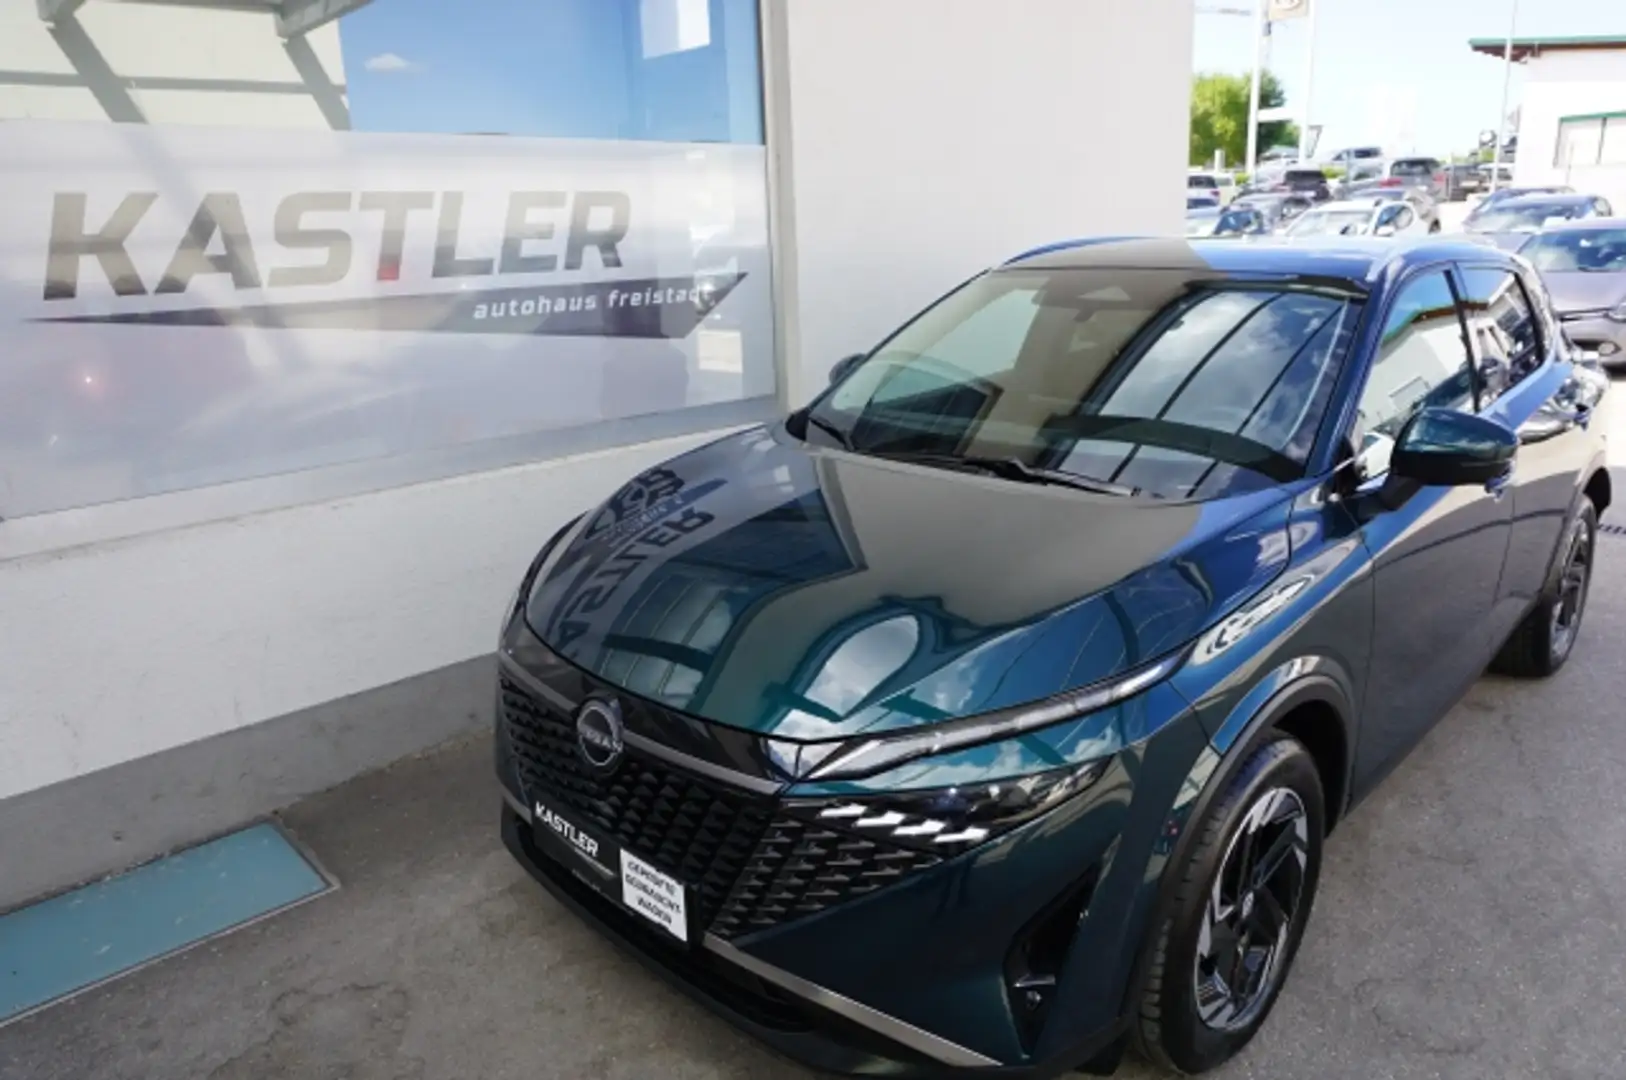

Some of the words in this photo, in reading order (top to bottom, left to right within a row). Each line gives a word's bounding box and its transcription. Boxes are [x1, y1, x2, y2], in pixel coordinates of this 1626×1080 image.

[42, 191, 631, 301] KASTLER
[473, 293, 597, 320] autohaus
[535, 801, 599, 857] KASTLER
